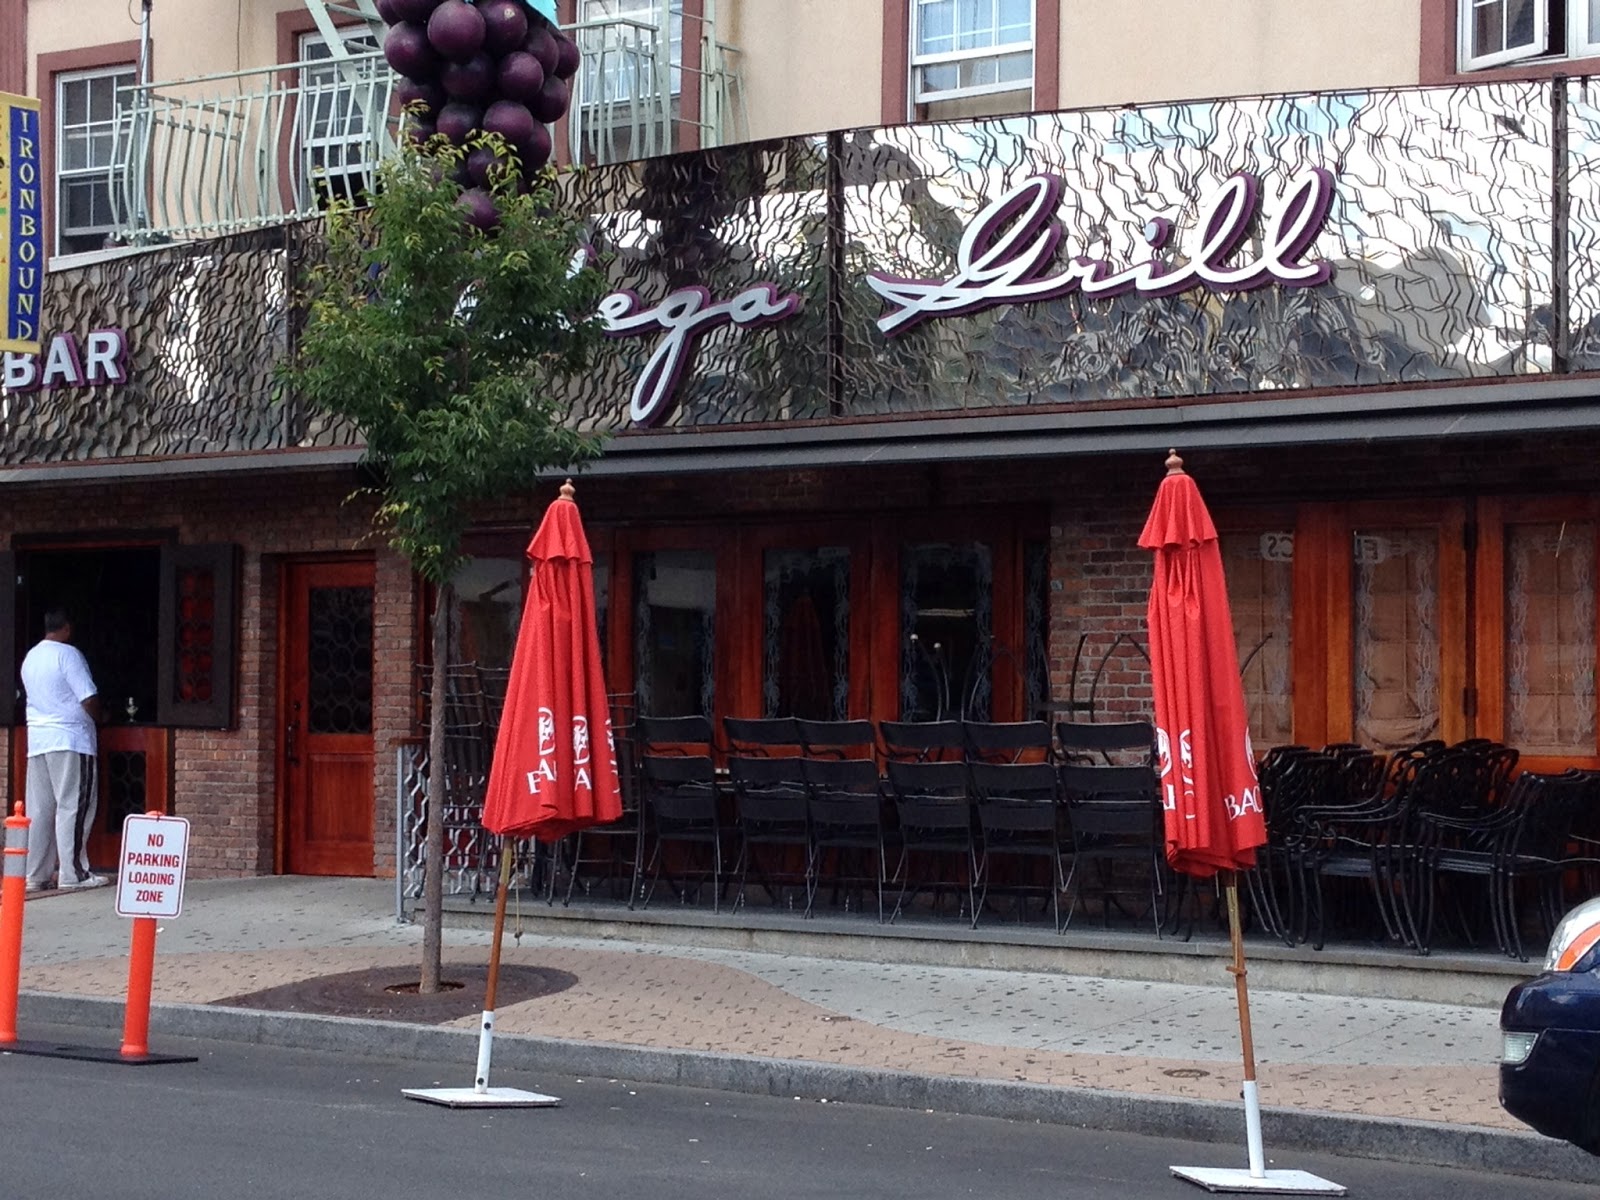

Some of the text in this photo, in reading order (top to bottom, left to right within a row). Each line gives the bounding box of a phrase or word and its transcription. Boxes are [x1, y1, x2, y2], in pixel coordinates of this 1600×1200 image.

[17, 111, 36, 341] IRONBOUND
[866, 168, 1332, 336] Grill
[3, 331, 124, 389] BAR
[147, 834, 165, 848] NO
[127, 852, 180, 867] PARKING
[128, 871, 175, 885] LOADING
[135, 890, 164, 903] ZONE
